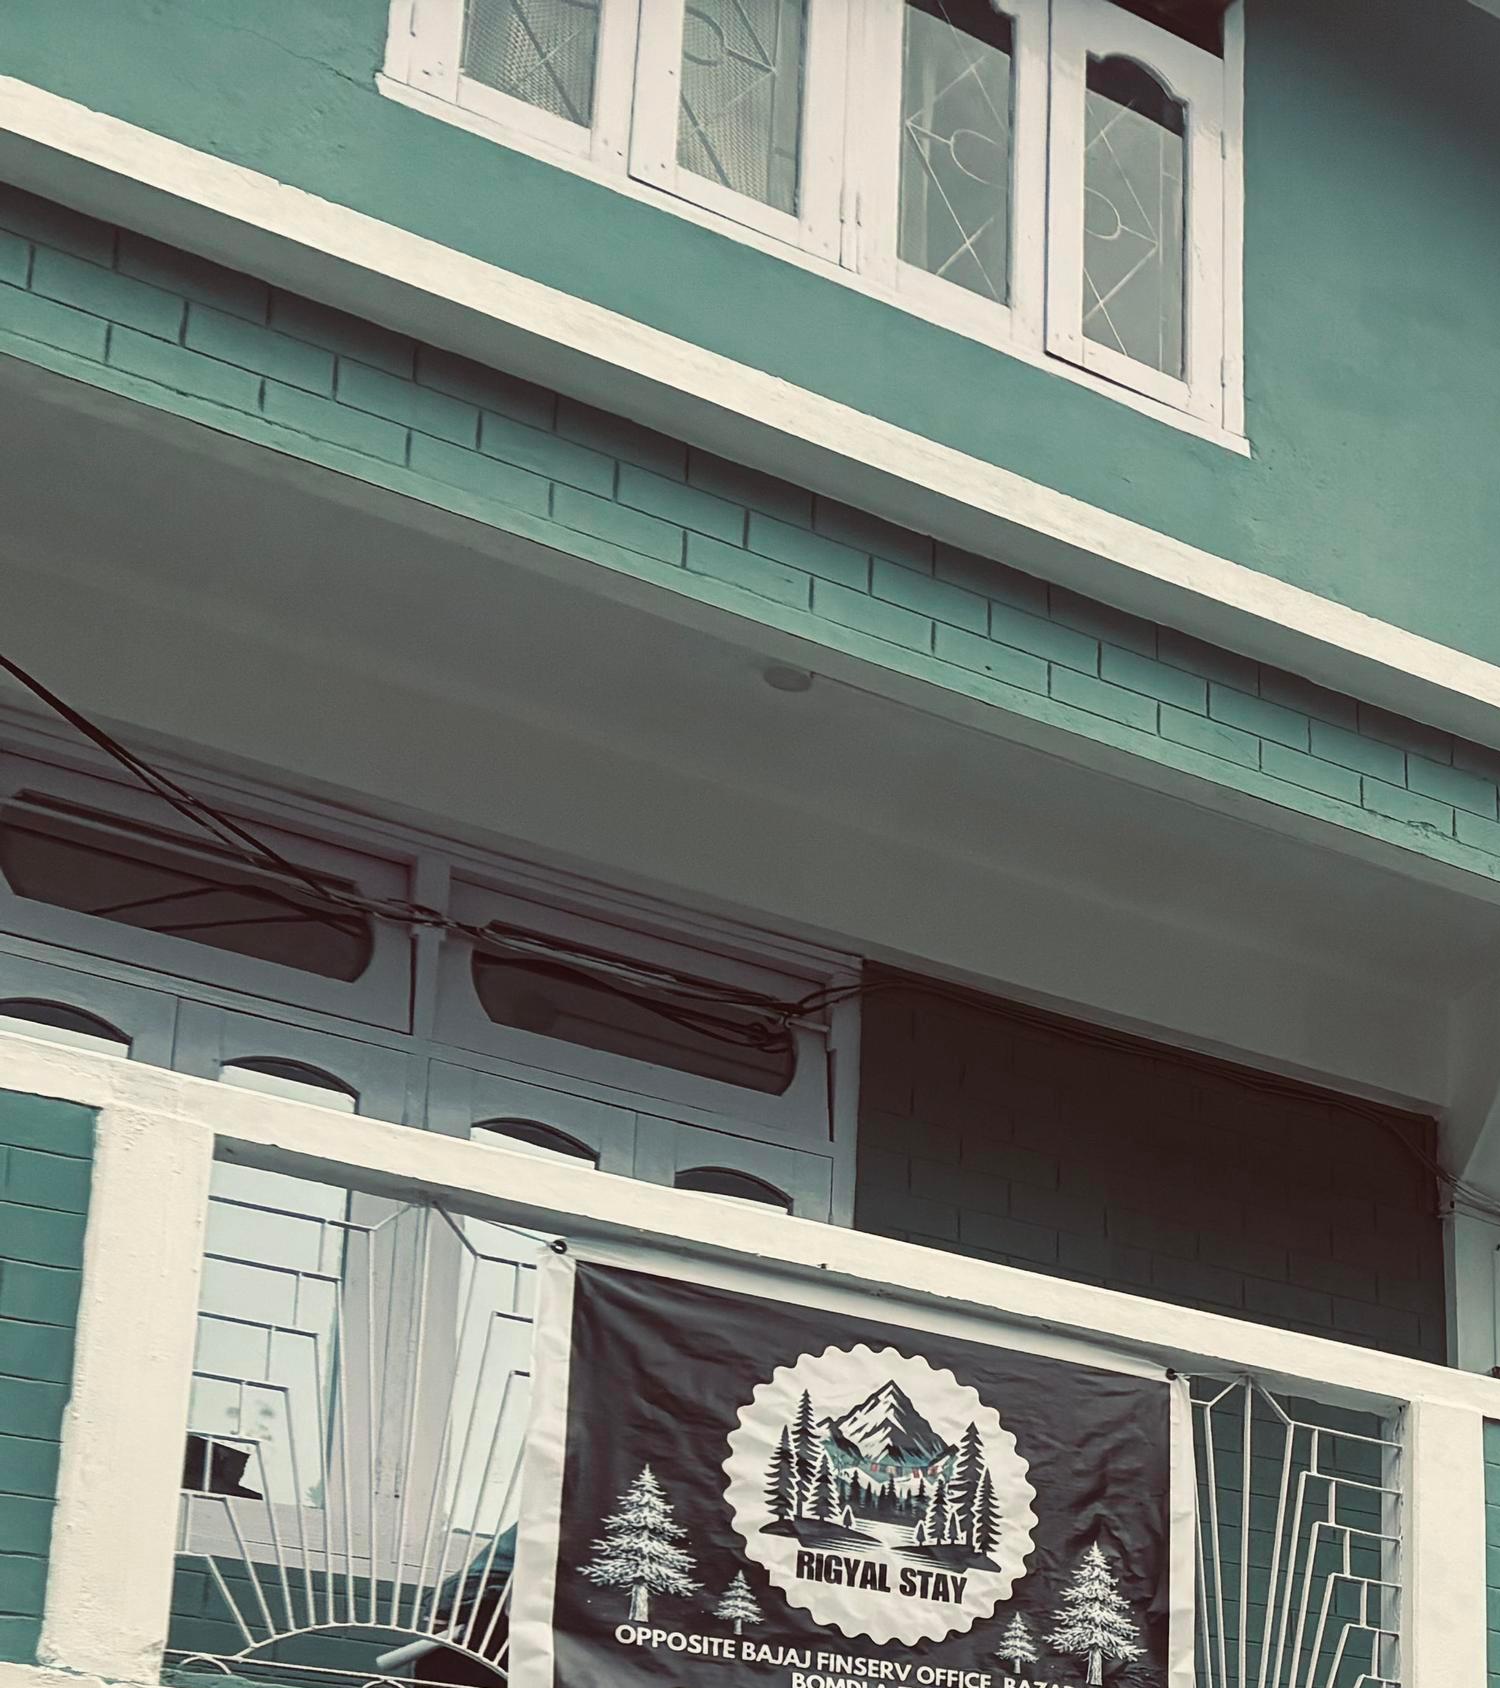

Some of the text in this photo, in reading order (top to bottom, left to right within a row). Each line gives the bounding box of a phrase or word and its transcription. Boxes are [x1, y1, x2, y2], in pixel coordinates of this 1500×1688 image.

[795, 1548, 968, 1604] RIGYAL STAY
[615, 1624, 736, 1661] OPPOSITE
[741, 1643, 811, 1669] BAJAJ
[817, 1653, 912, 1682] FINSERV
